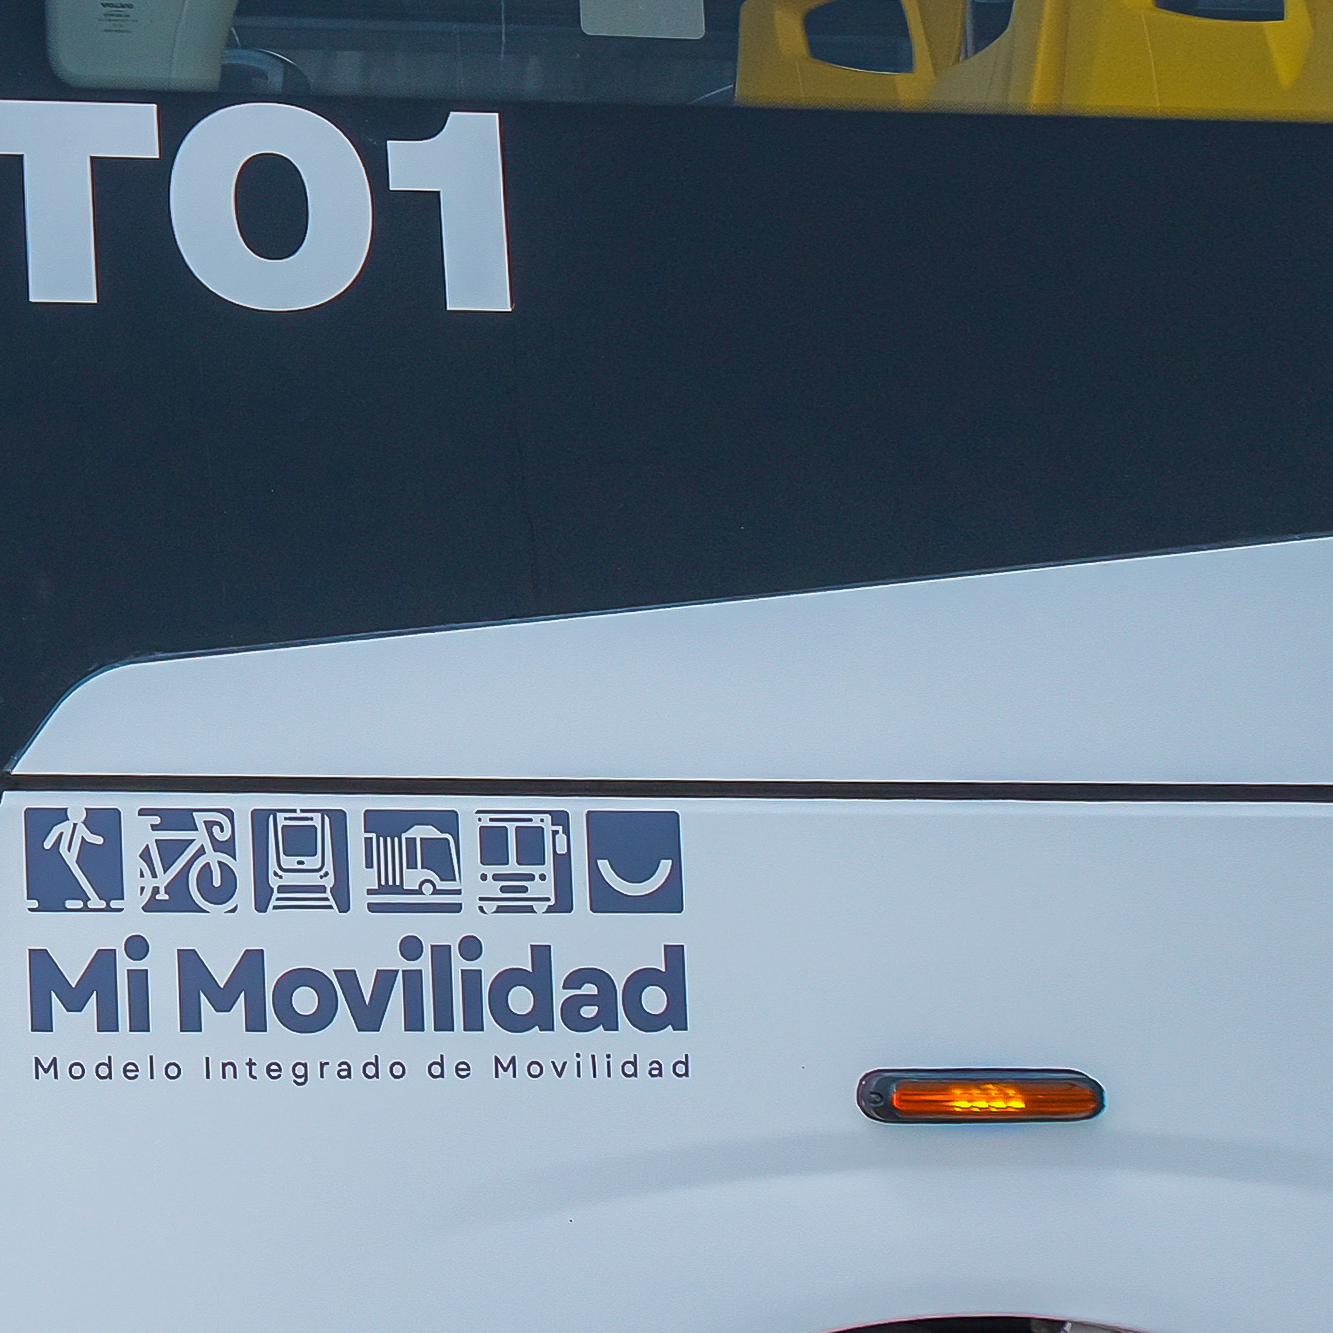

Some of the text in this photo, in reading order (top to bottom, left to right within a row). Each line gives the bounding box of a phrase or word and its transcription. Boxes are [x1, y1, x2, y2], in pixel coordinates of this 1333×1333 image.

[27, 934, 689, 1034] Mi Movilidad
[34, 1052, 691, 1088] Modelo Integrado de Movilidad
